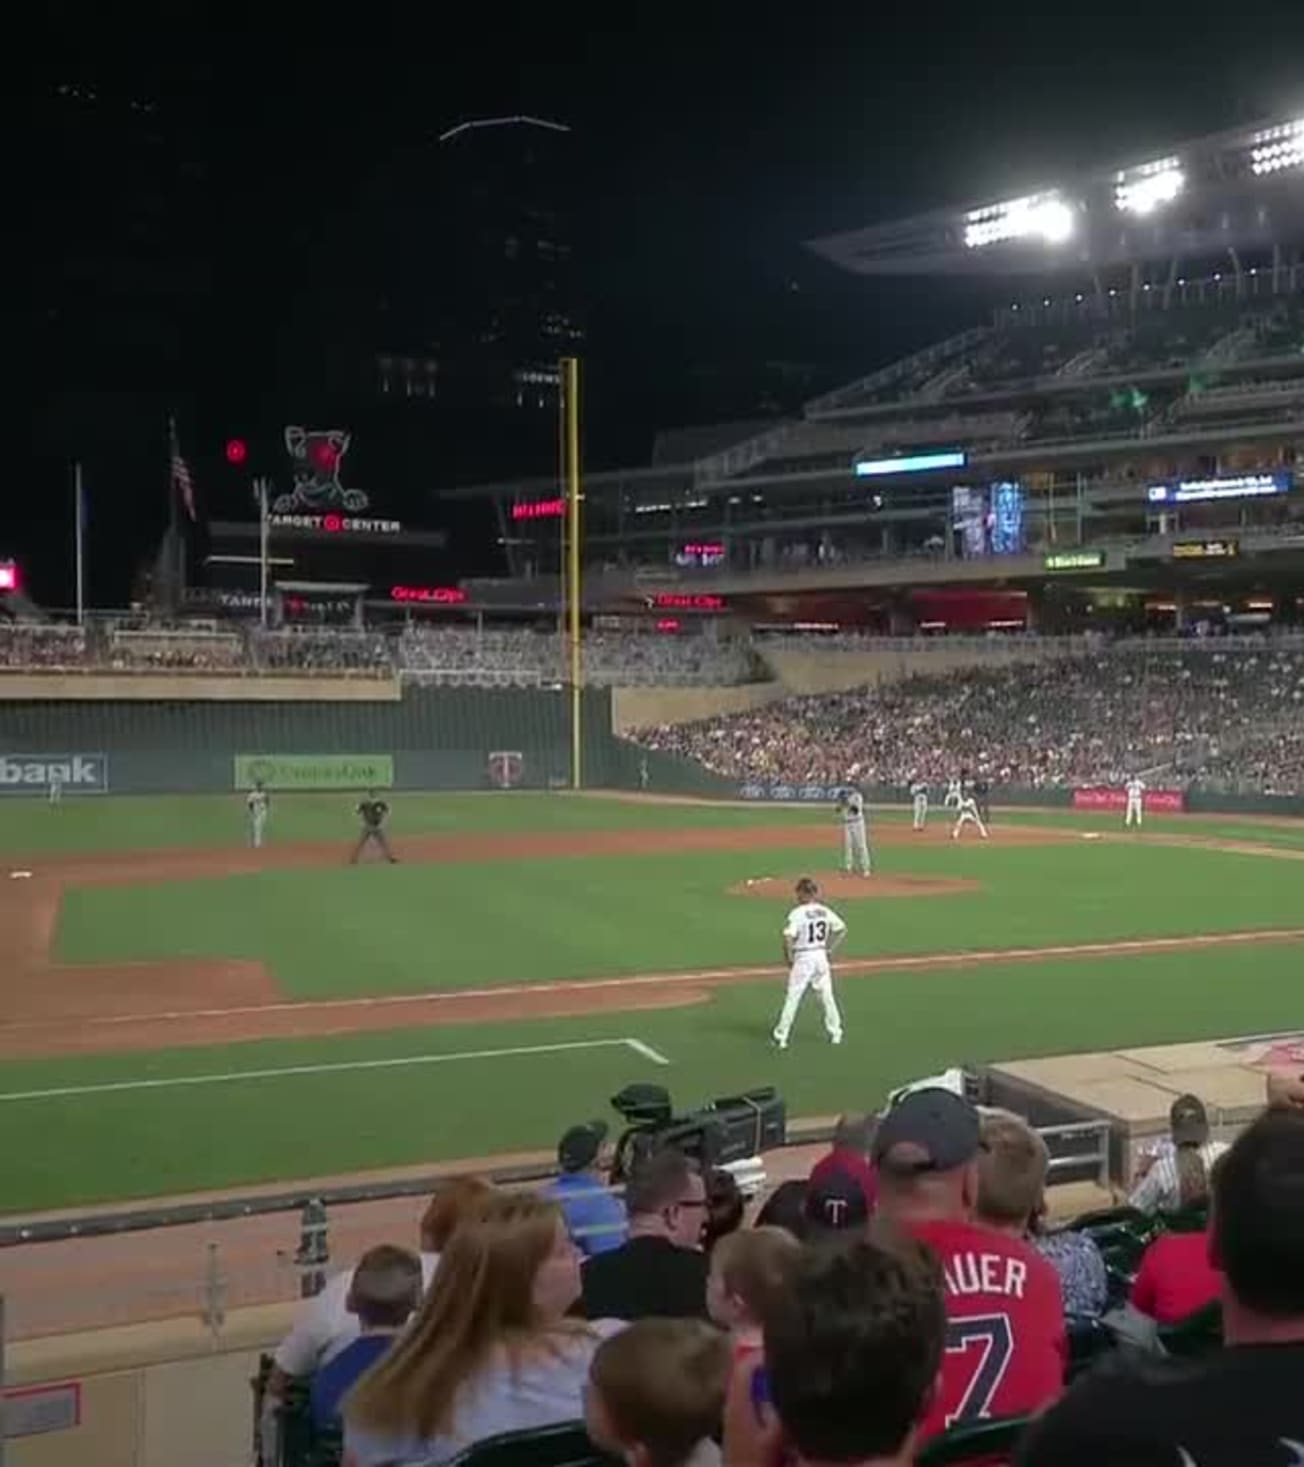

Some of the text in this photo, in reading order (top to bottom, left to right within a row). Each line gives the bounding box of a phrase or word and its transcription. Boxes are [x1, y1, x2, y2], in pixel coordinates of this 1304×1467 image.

[342, 518, 400, 533] CENTER
[0, 756, 97, 784] bank
[808, 920, 827, 943] 13
[946, 1313, 1014, 1430] 7
